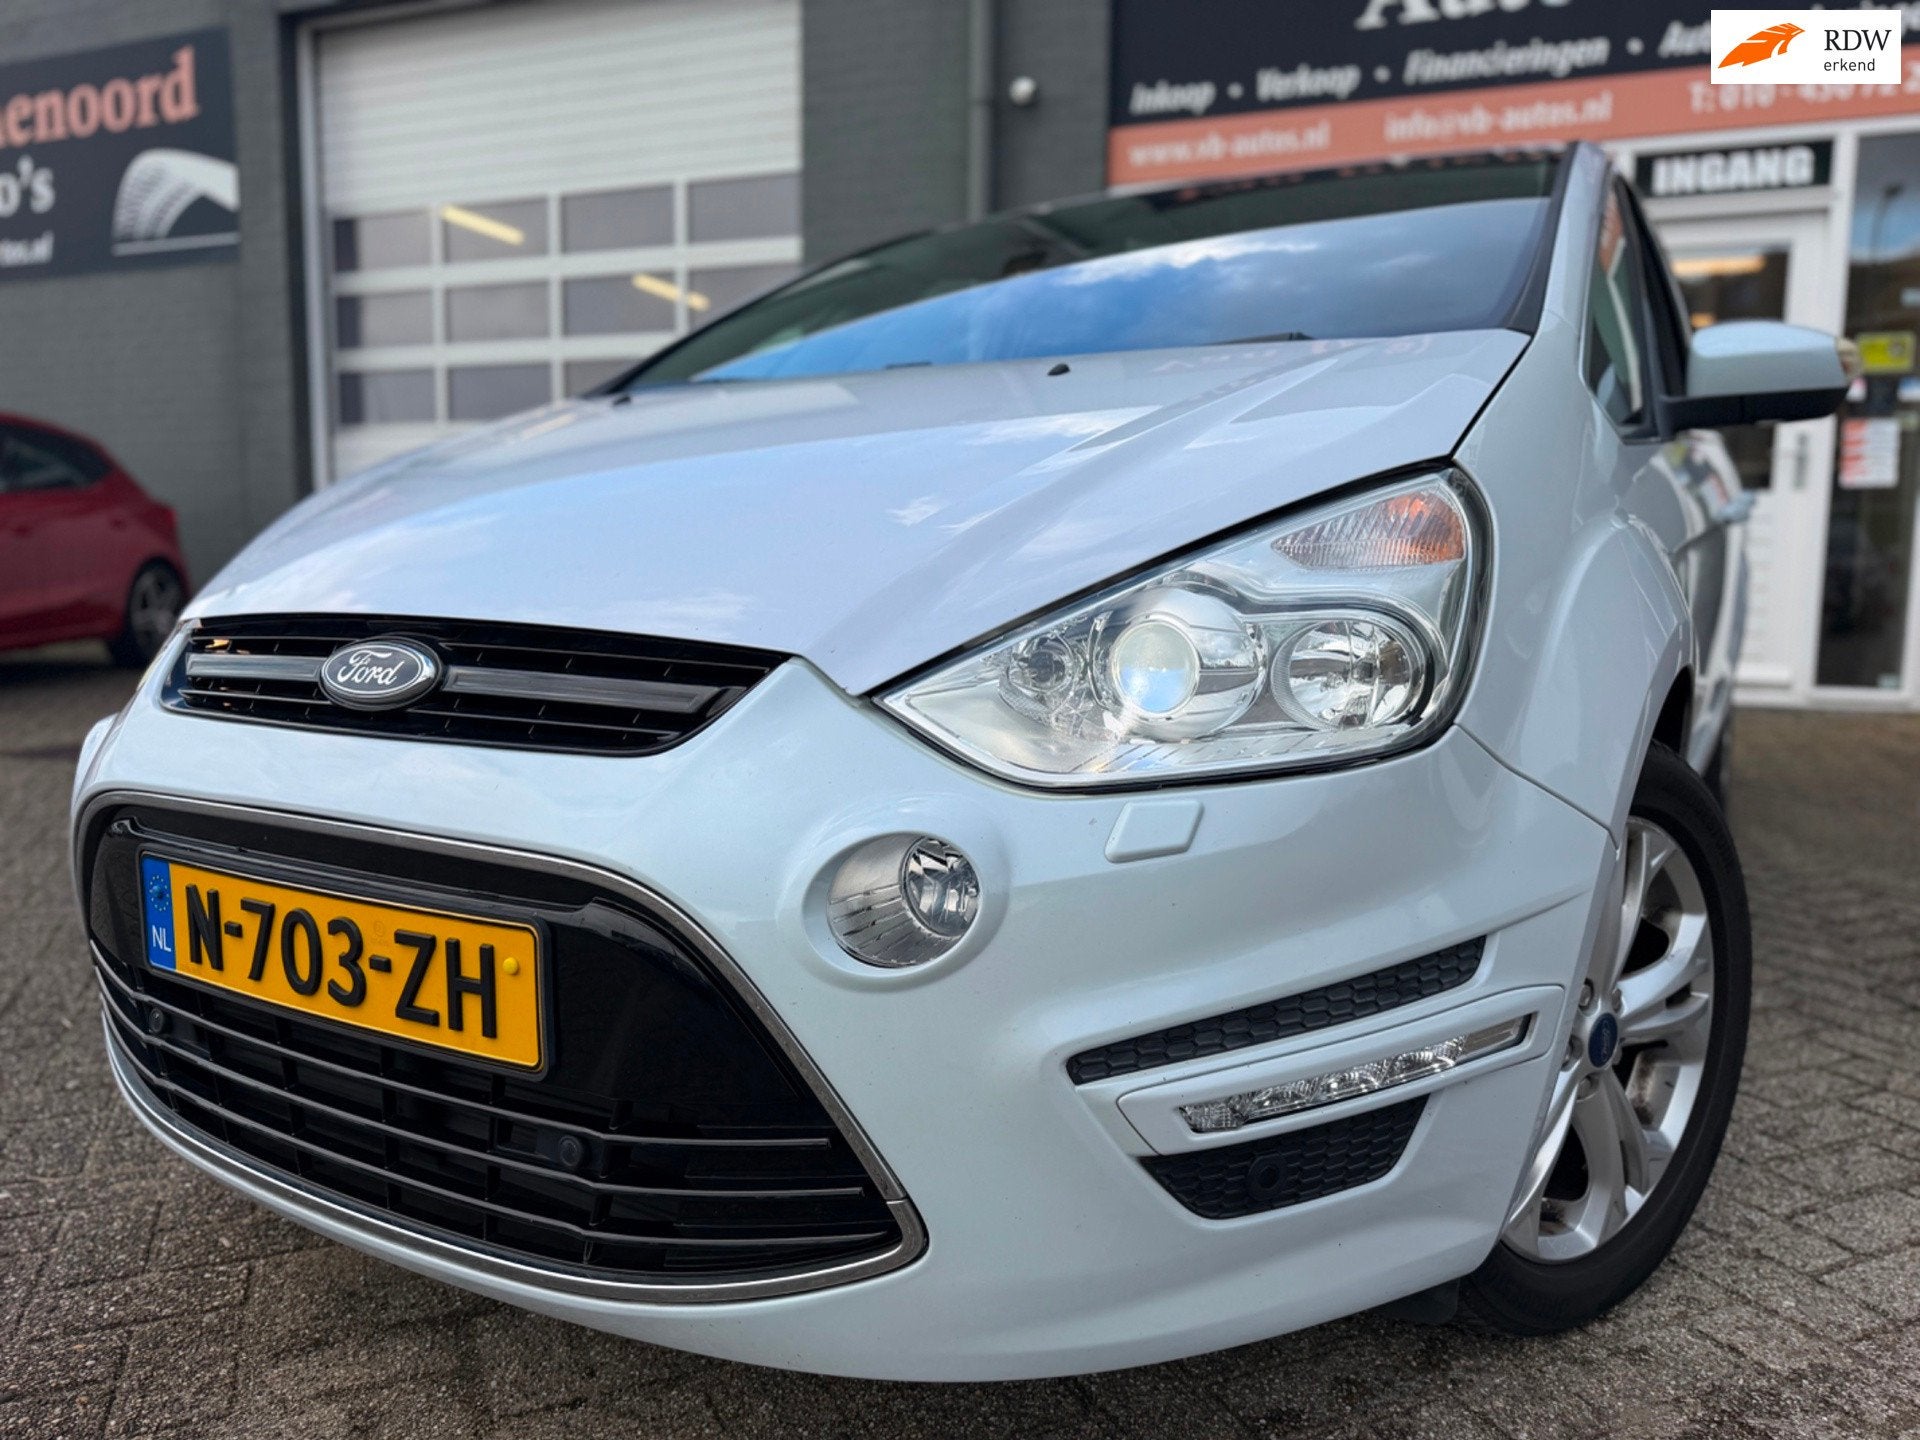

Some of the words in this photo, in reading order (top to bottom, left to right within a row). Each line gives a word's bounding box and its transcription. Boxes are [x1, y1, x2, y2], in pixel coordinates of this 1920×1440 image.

[0, 44, 200, 148] enoord
[1652, 146, 1816, 197] INGANG
[337, 650, 405, 686] Ford
[151, 925, 172, 952] NL
[185, 884, 497, 1039] N-703-ZH
